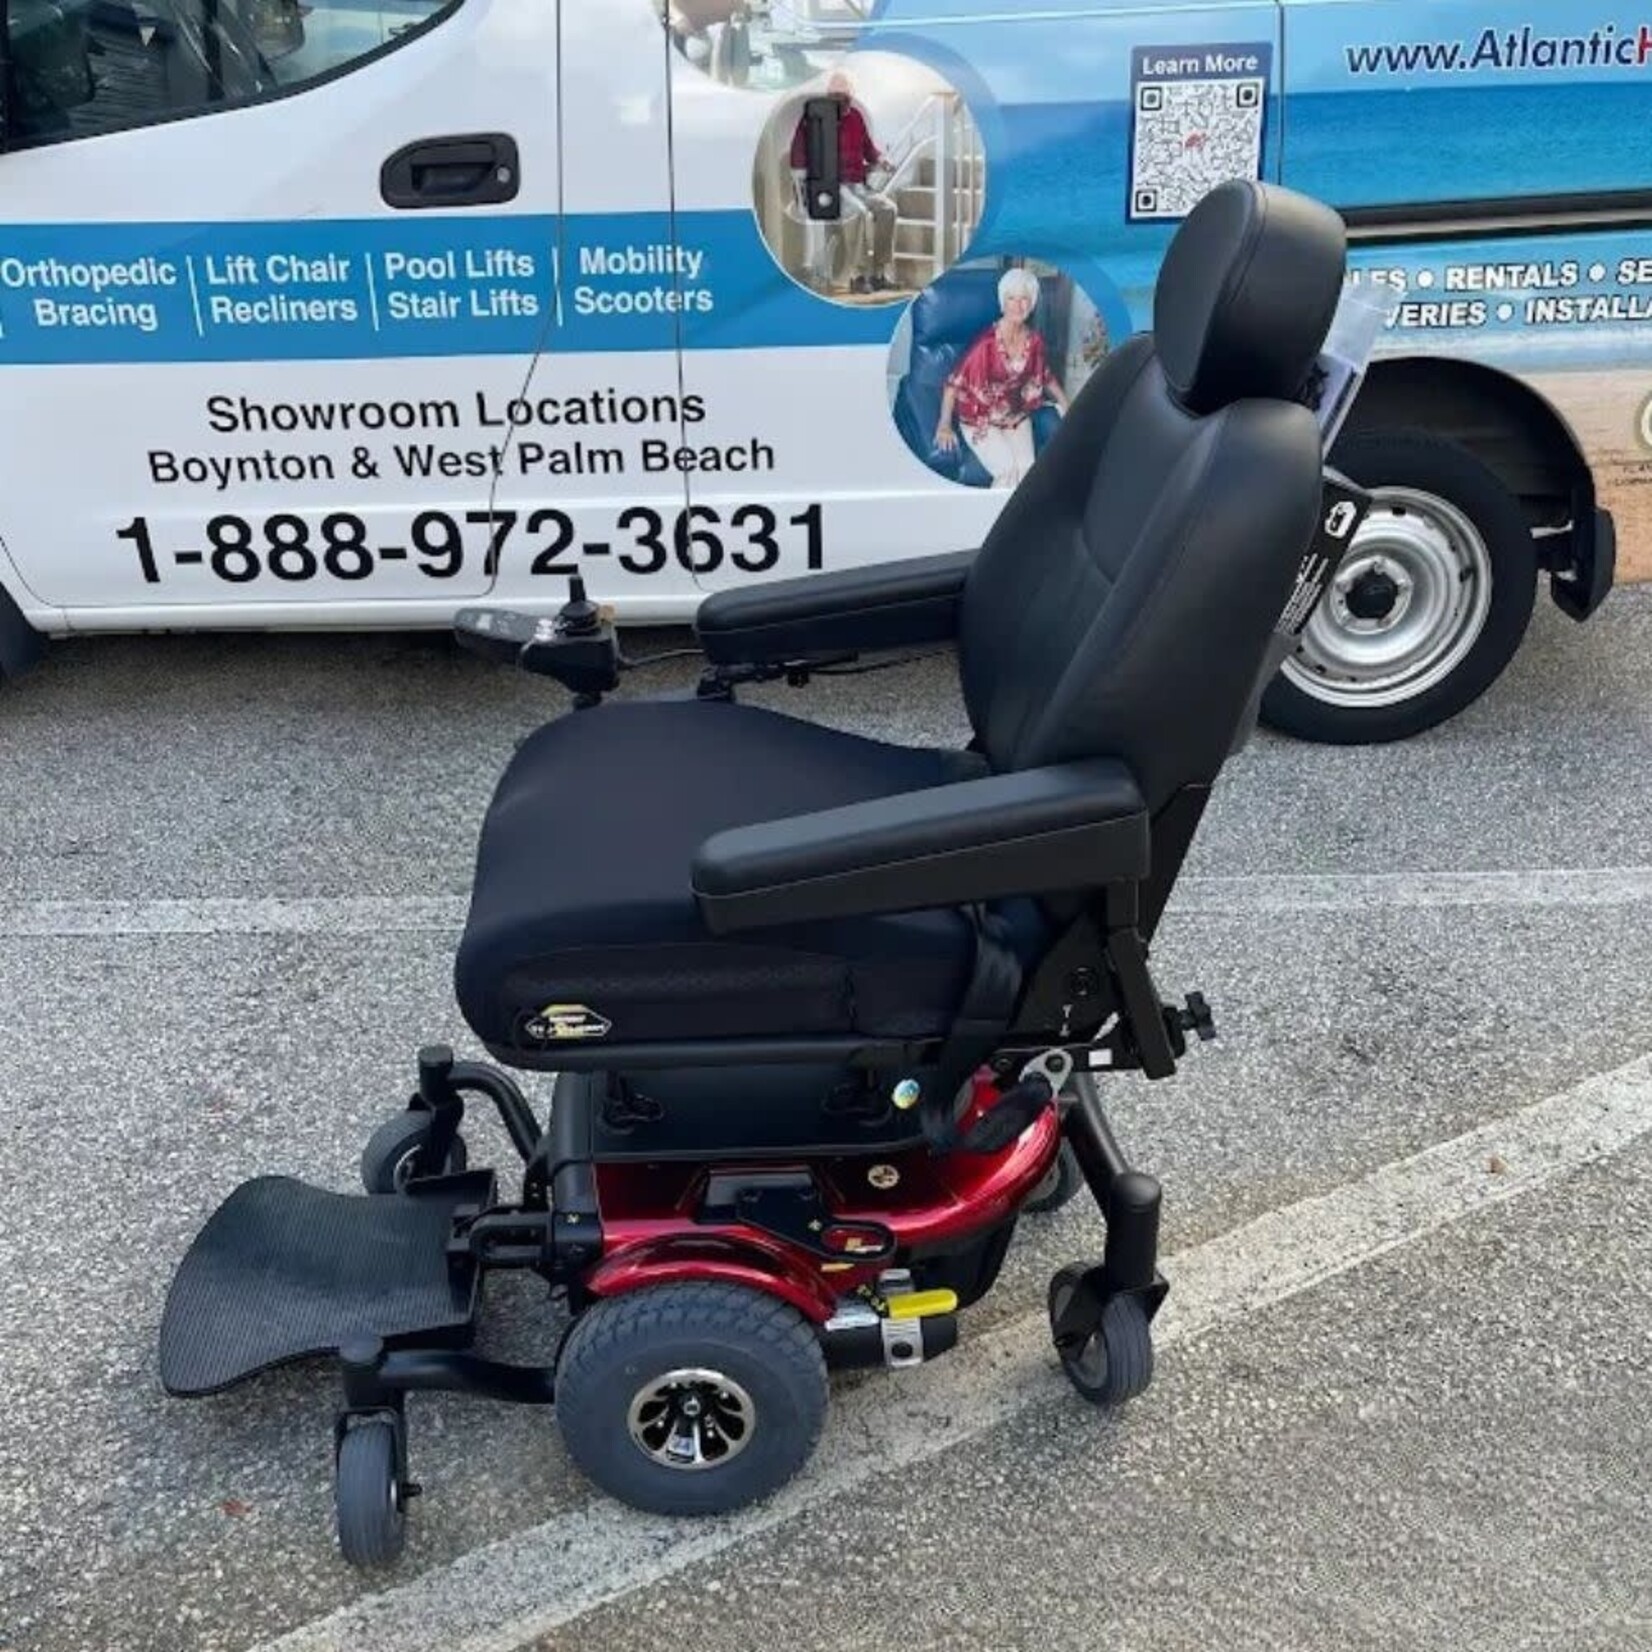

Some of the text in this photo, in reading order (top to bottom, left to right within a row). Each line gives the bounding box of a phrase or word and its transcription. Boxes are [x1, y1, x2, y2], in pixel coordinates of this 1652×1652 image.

[1142, 53, 1259, 75] Learn More
[1, 257, 177, 293] Orthopedic
[206, 253, 350, 285] Lift Chair
[384, 249, 535, 280] Pool Lifts
[579, 244, 704, 280] Mobility
[1445, 261, 1579, 292] RENTALS
[33, 297, 158, 332] Bracing
[210, 294, 359, 324] Recliners
[388, 288, 539, 320] Stair Lifts
[574, 285, 714, 315] Scooters
[1524, 295, 1652, 325] INSTALL
[206, 387, 706, 433] Showroom Locations
[147, 438, 775, 491] Boynton & West Palm Beach
[115, 502, 824, 583] 1-888-972-3631
